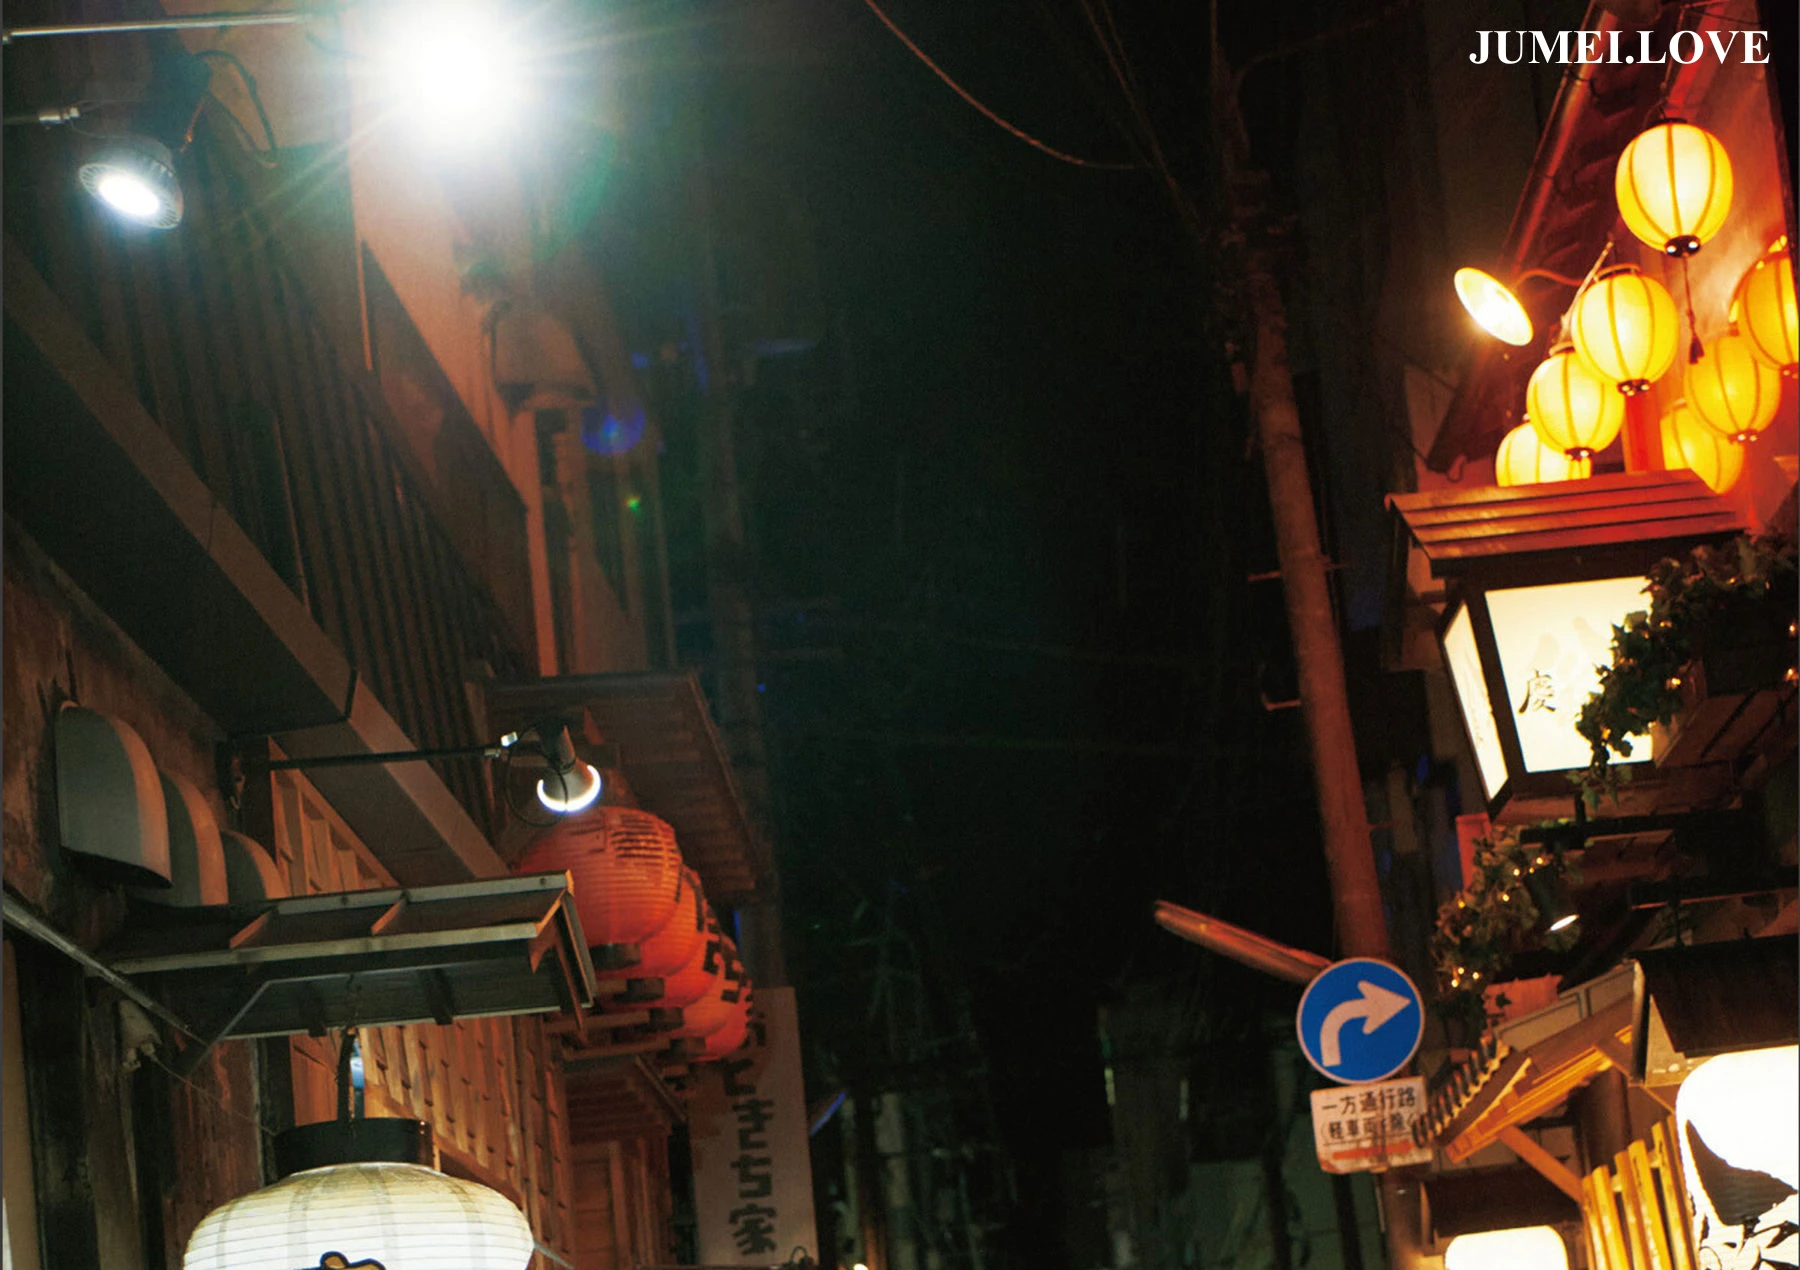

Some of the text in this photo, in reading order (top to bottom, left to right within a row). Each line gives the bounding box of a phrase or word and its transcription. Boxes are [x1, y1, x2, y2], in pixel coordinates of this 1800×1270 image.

[1320, 1086, 1416, 1116] 一方通行路
